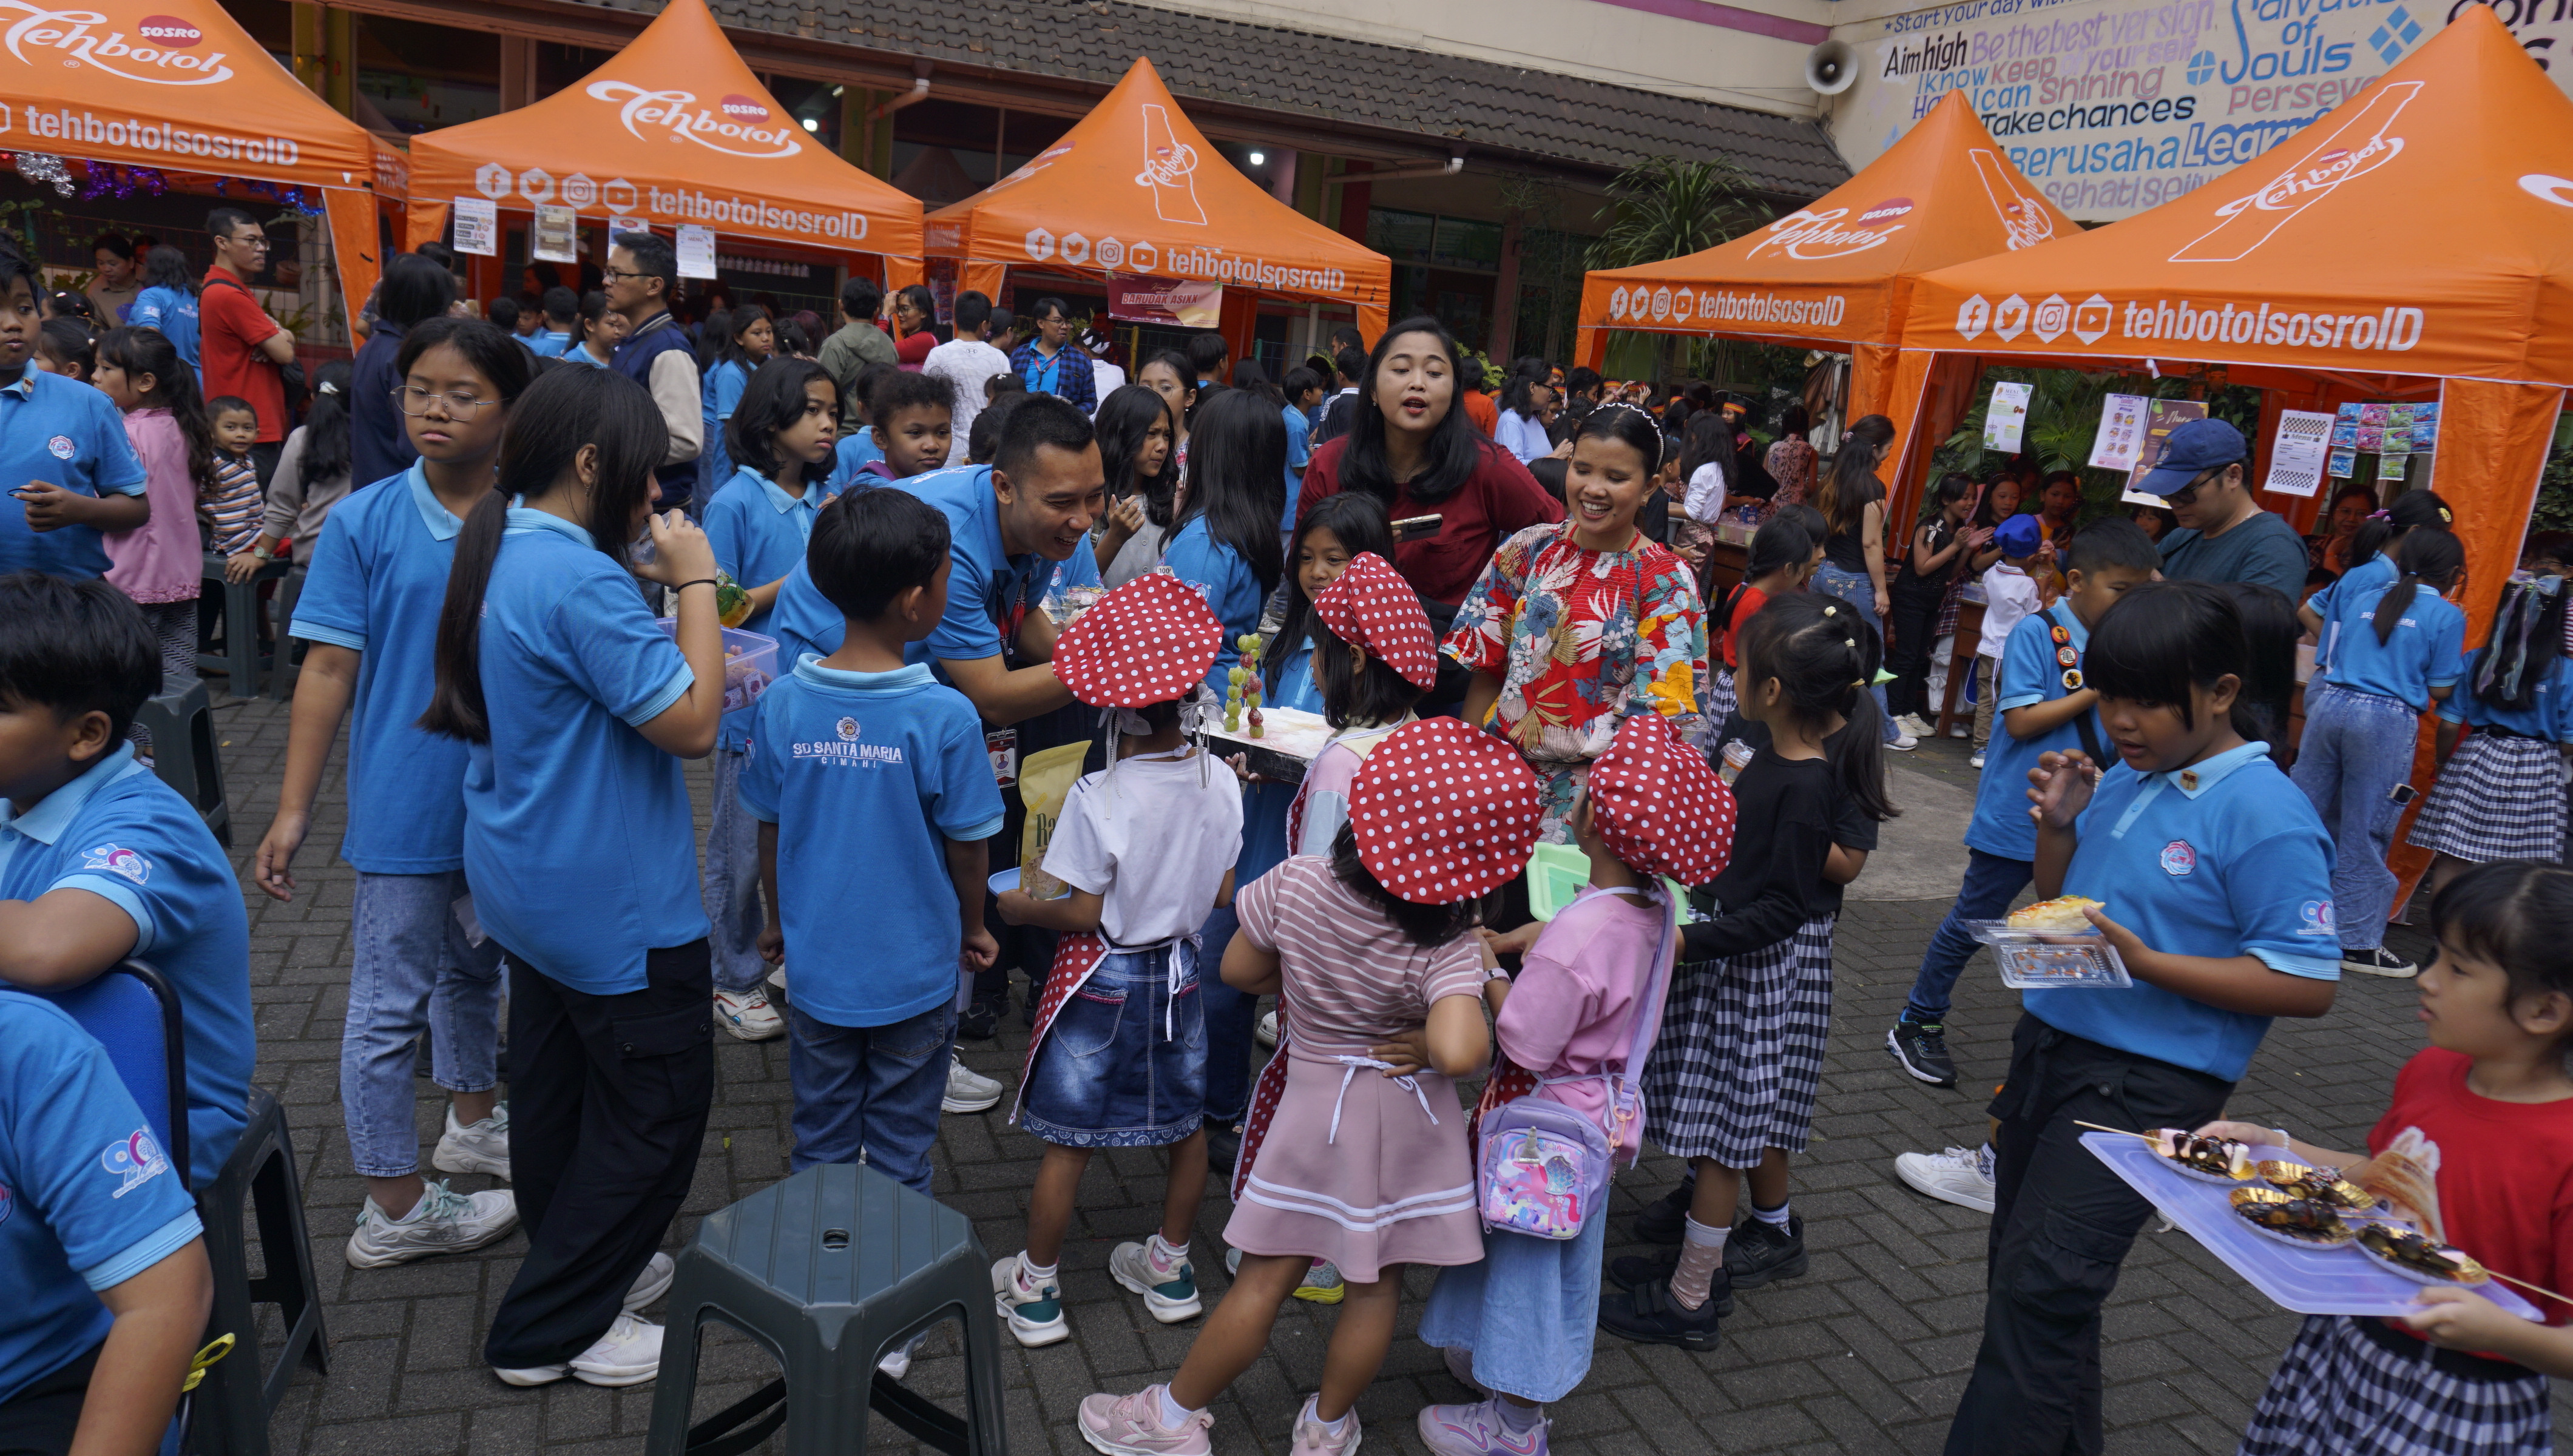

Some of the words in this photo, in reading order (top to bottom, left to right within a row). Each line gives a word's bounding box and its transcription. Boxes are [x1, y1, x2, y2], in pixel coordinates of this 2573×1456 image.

[140, 26, 201, 39] SOSRO
[1894, 10, 1941, 33] Start
[1944, 1, 1988, 25] your
[1990, 0, 2024, 16] day
[2282, 13, 2320, 47] of
[0, 0, 234, 86] Tehbotol
[1884, 46, 1921, 78] Aim
[1922, 30, 1969, 72] high
[1970, 30, 2005, 65] Be
[2085, 33, 2199, 75] yourself
[2039, 66, 2166, 106] Shining
[586, 79, 802, 158] Tehbotol
[722, 103, 768, 116] SOSRO
[2048, 95, 2197, 130] chances
[2215, 134, 2405, 217] Tehbotol
[1858, 206, 1913, 222] SOSRO
[1746, 207, 1907, 260] Tehbotol
[1122, 293, 1169, 305] BARUDAK
[1170, 294, 1200, 305] ASIXX
[793, 743, 811, 755] SD
[814, 741, 858, 757] SANTA
[860, 744, 903, 761] MARIA
[821, 756, 876, 769] CIMAHI
